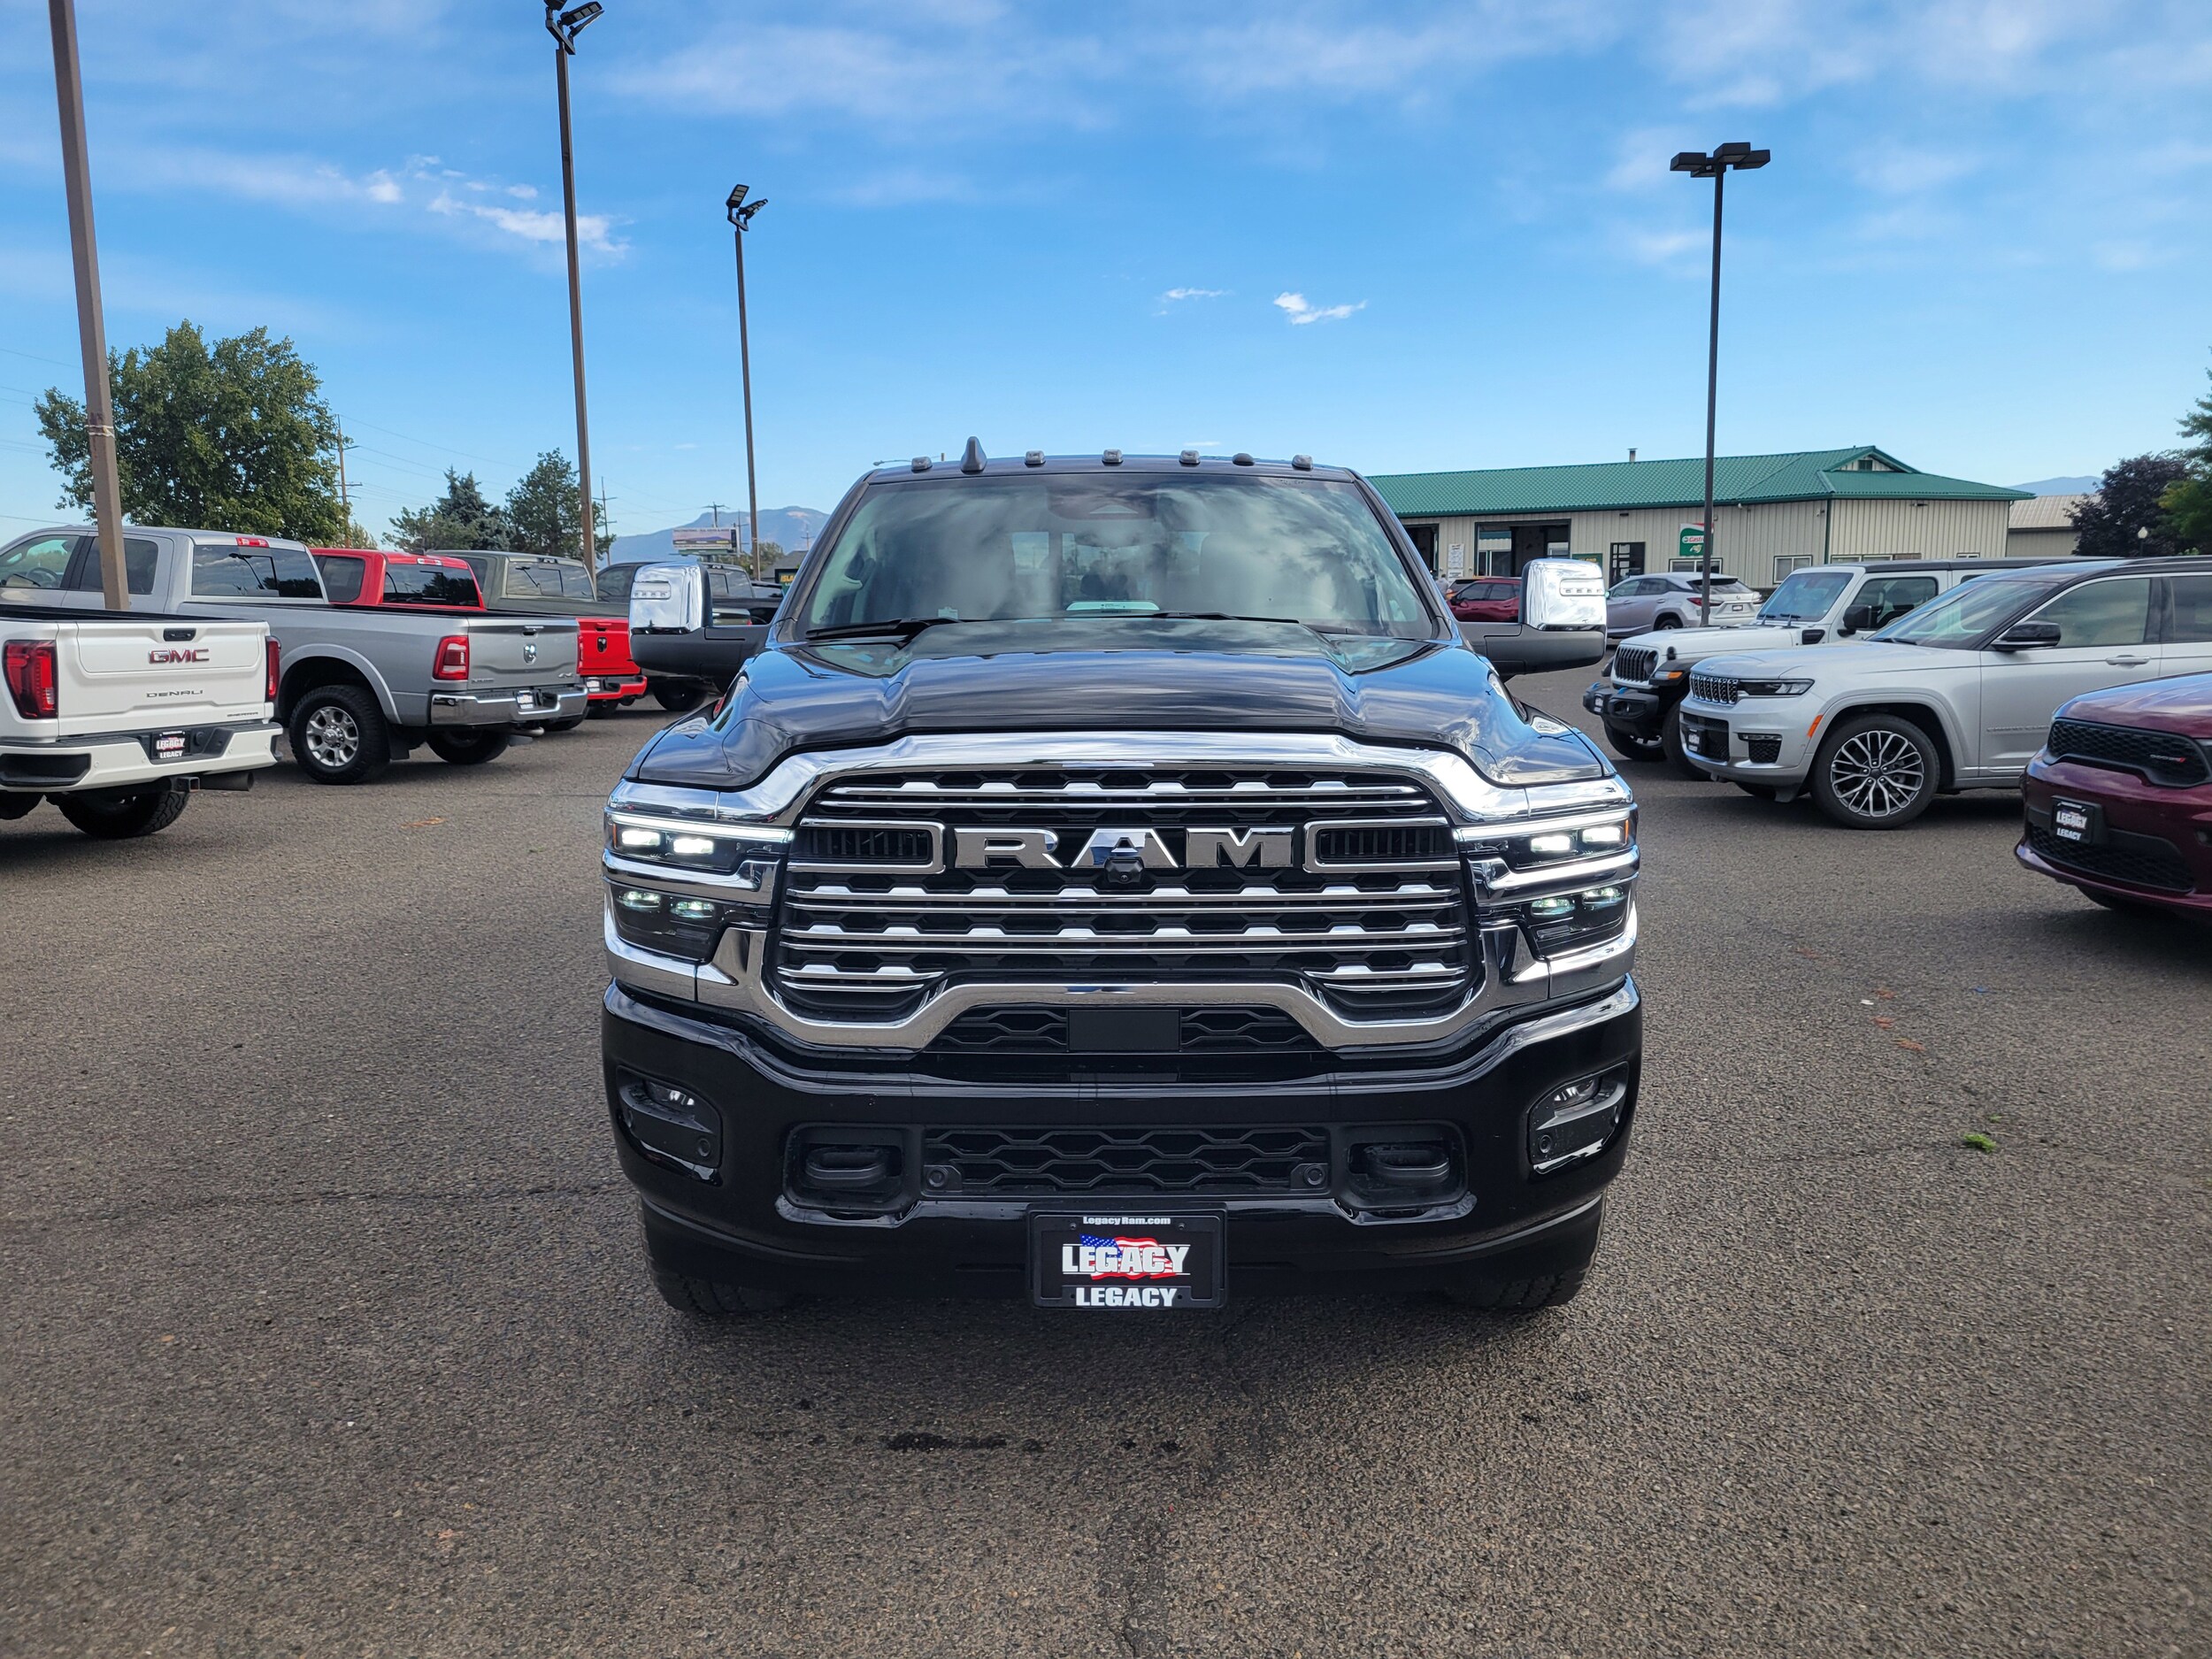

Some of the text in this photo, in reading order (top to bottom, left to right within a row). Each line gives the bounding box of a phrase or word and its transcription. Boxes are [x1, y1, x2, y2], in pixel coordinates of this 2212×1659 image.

[149, 649, 210, 664] GMC
[156, 738, 185, 750] LEGACY
[2056, 810, 2087, 829] LEGACY
[2056, 827, 2082, 841] LEGACY
[954, 827, 1296, 869] RAM
[1062, 1246, 1190, 1273] LEGACY
[1076, 1287, 1178, 1307] LEGACY
